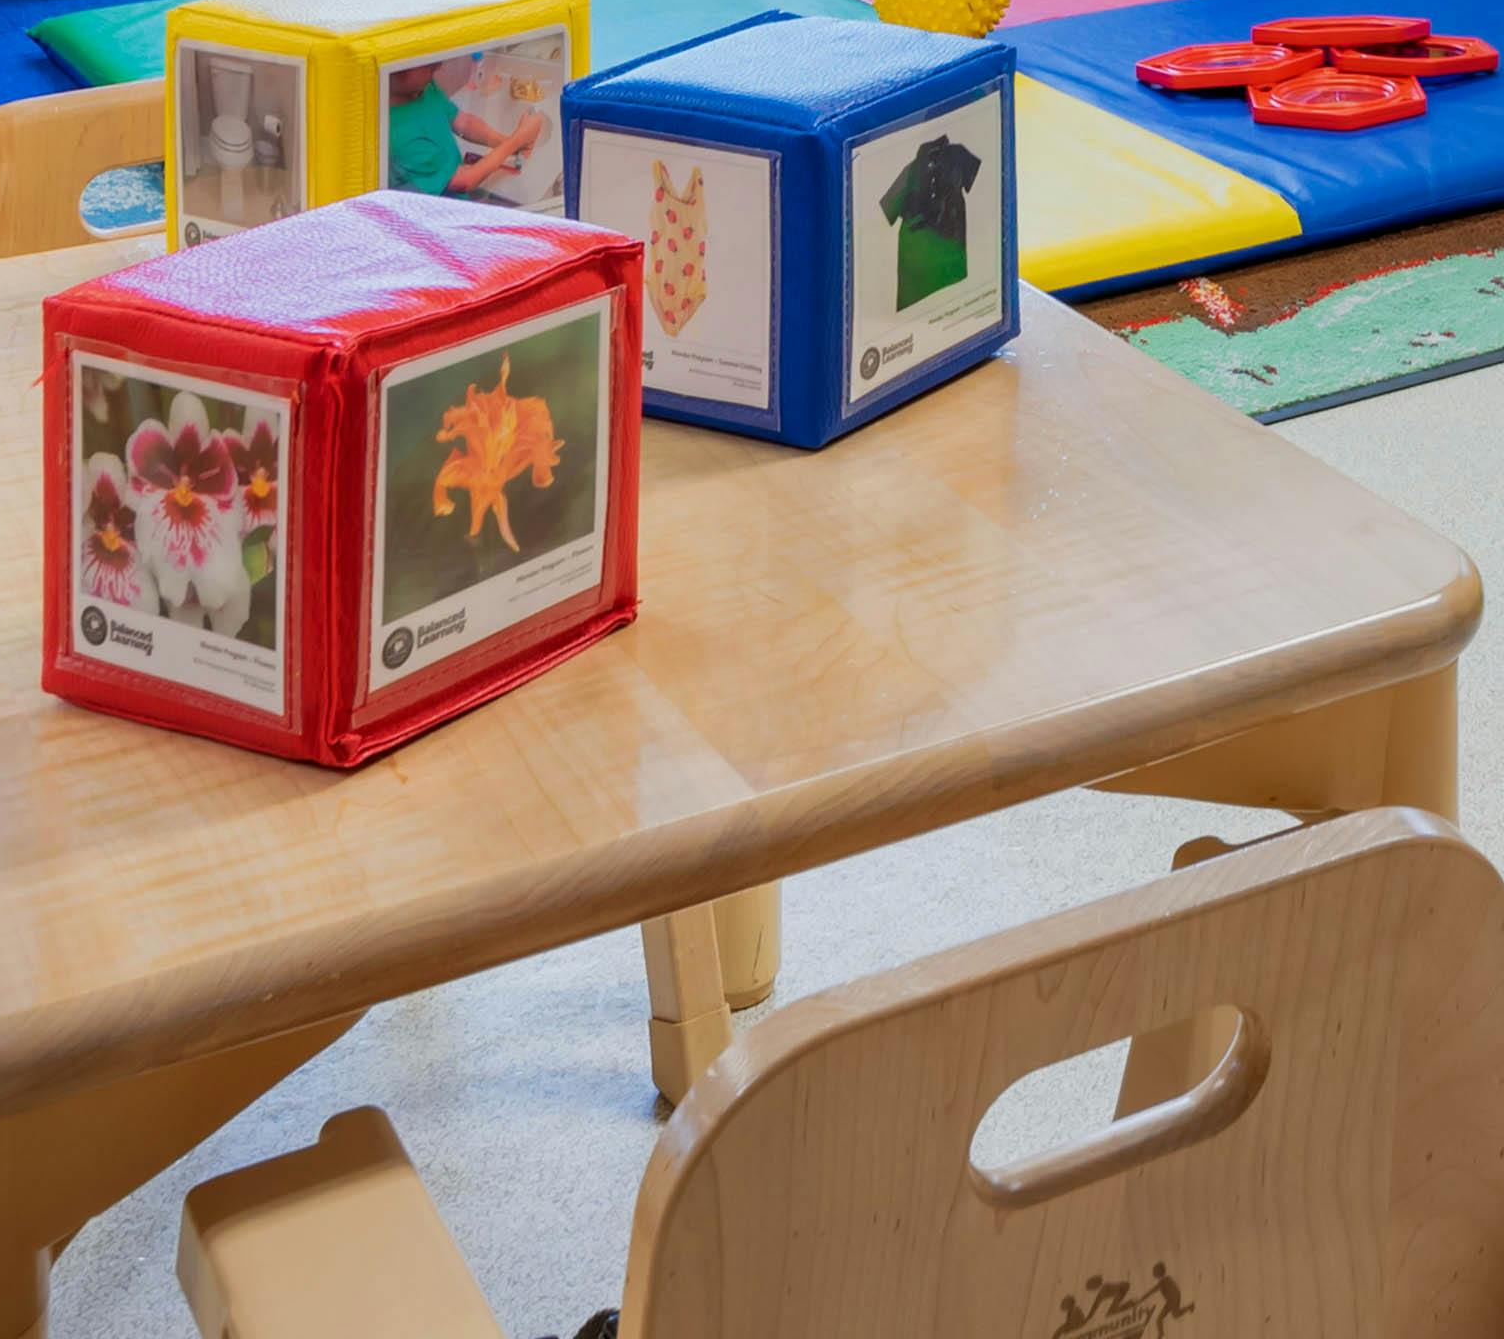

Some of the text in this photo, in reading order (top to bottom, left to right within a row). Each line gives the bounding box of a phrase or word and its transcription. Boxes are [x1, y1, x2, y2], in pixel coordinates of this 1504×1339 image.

[110, 618, 154, 643] Balanced
[417, 606, 466, 637] Balanced
[417, 619, 467, 649] Learning
[110, 631, 154, 656] Learning
